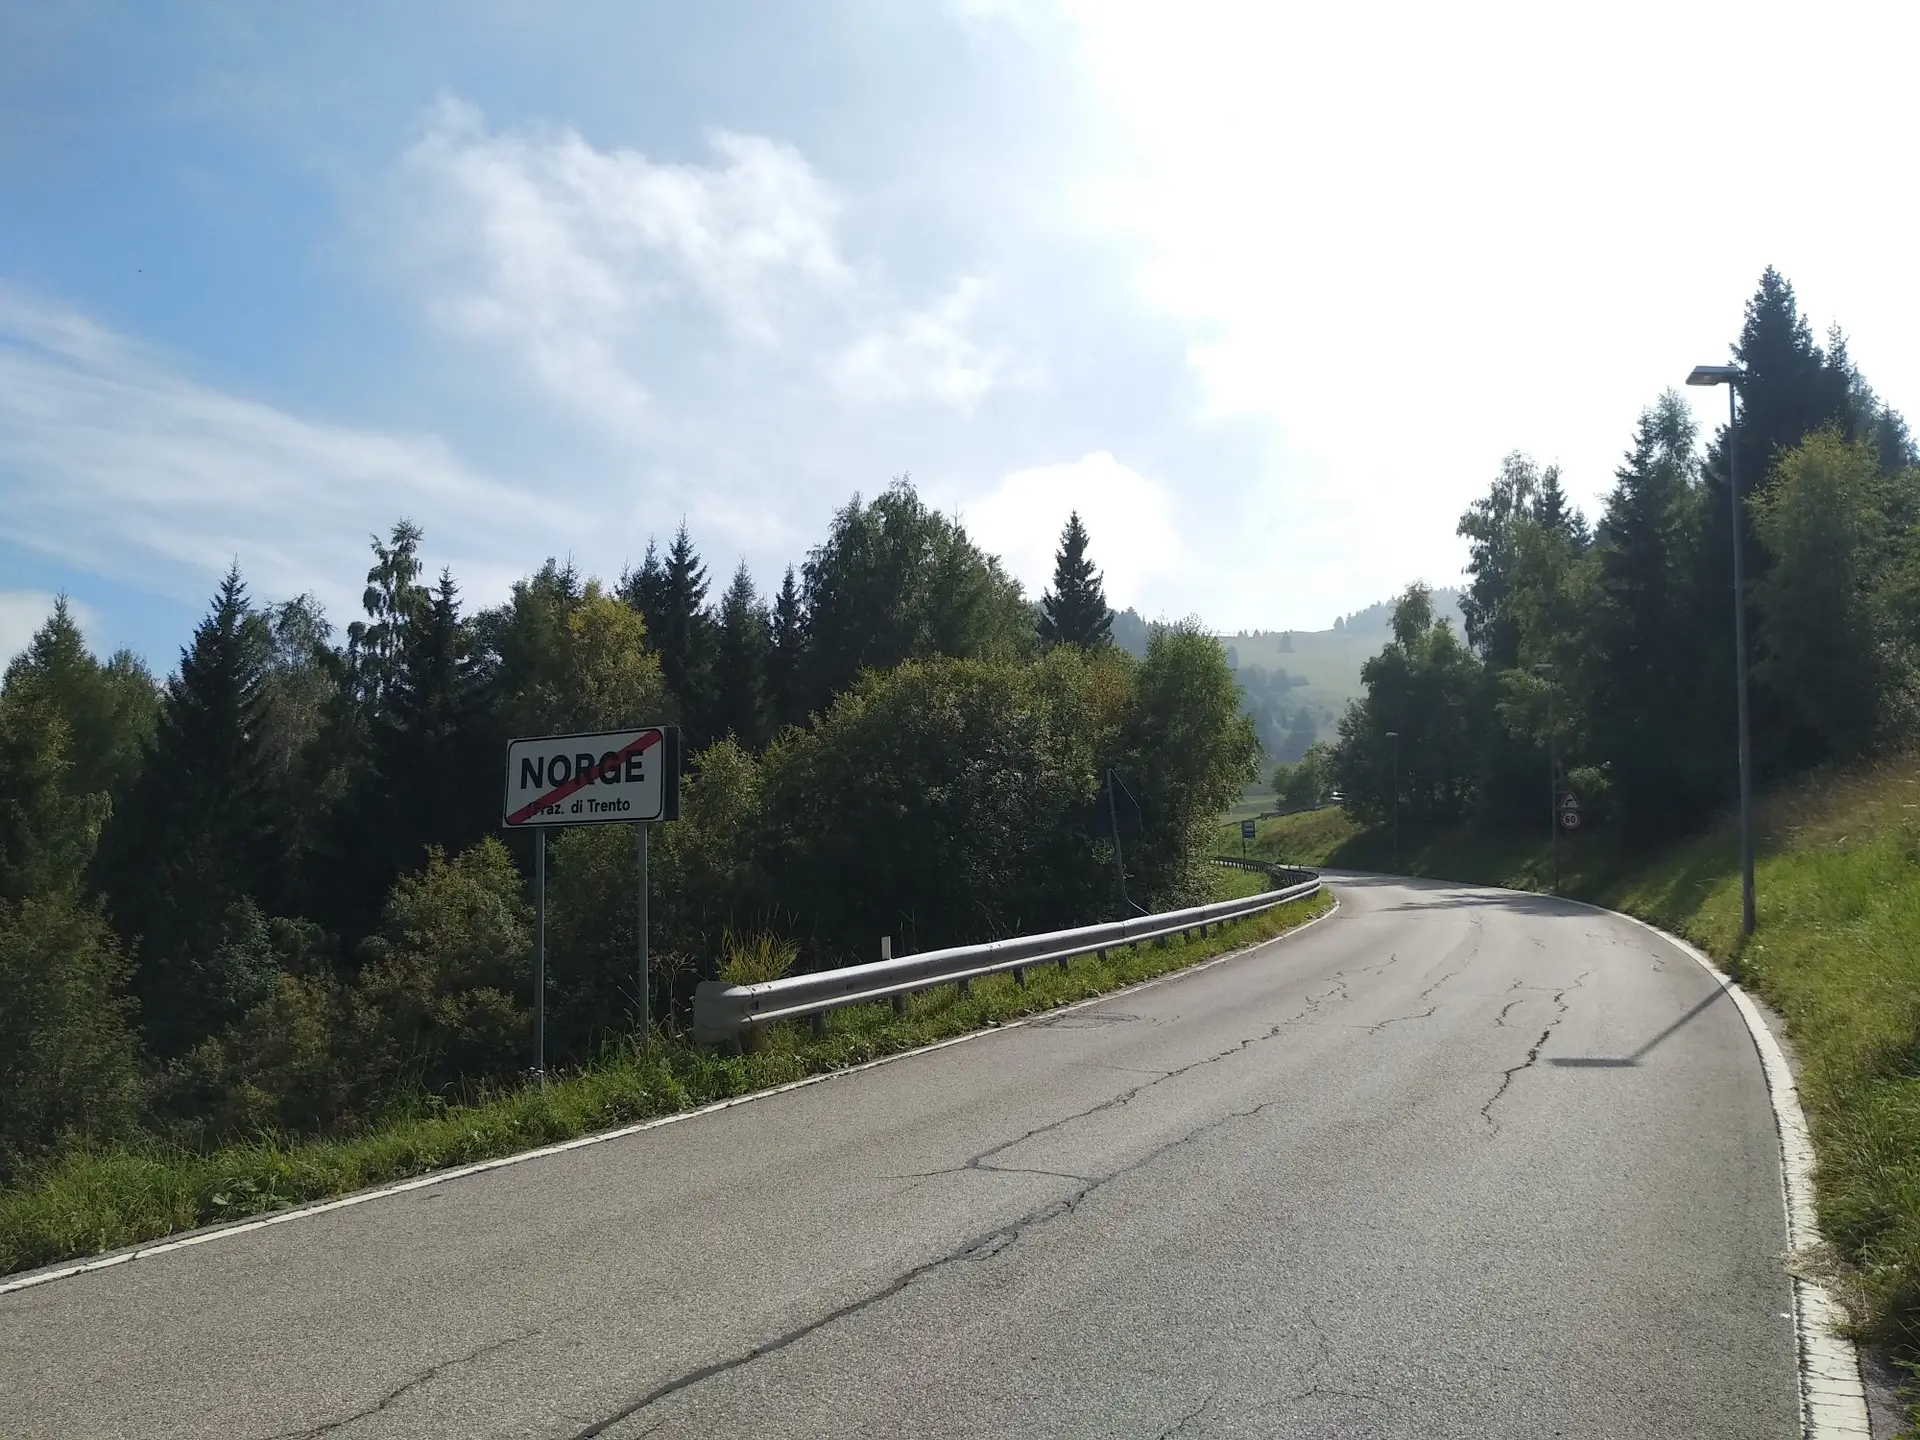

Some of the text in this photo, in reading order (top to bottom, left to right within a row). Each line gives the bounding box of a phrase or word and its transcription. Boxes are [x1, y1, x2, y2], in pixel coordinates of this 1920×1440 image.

[520, 748, 645, 790] NORGE
[571, 799, 583, 814] di
[587, 797, 631, 813] Trento
[1565, 815, 1575, 824] 60
